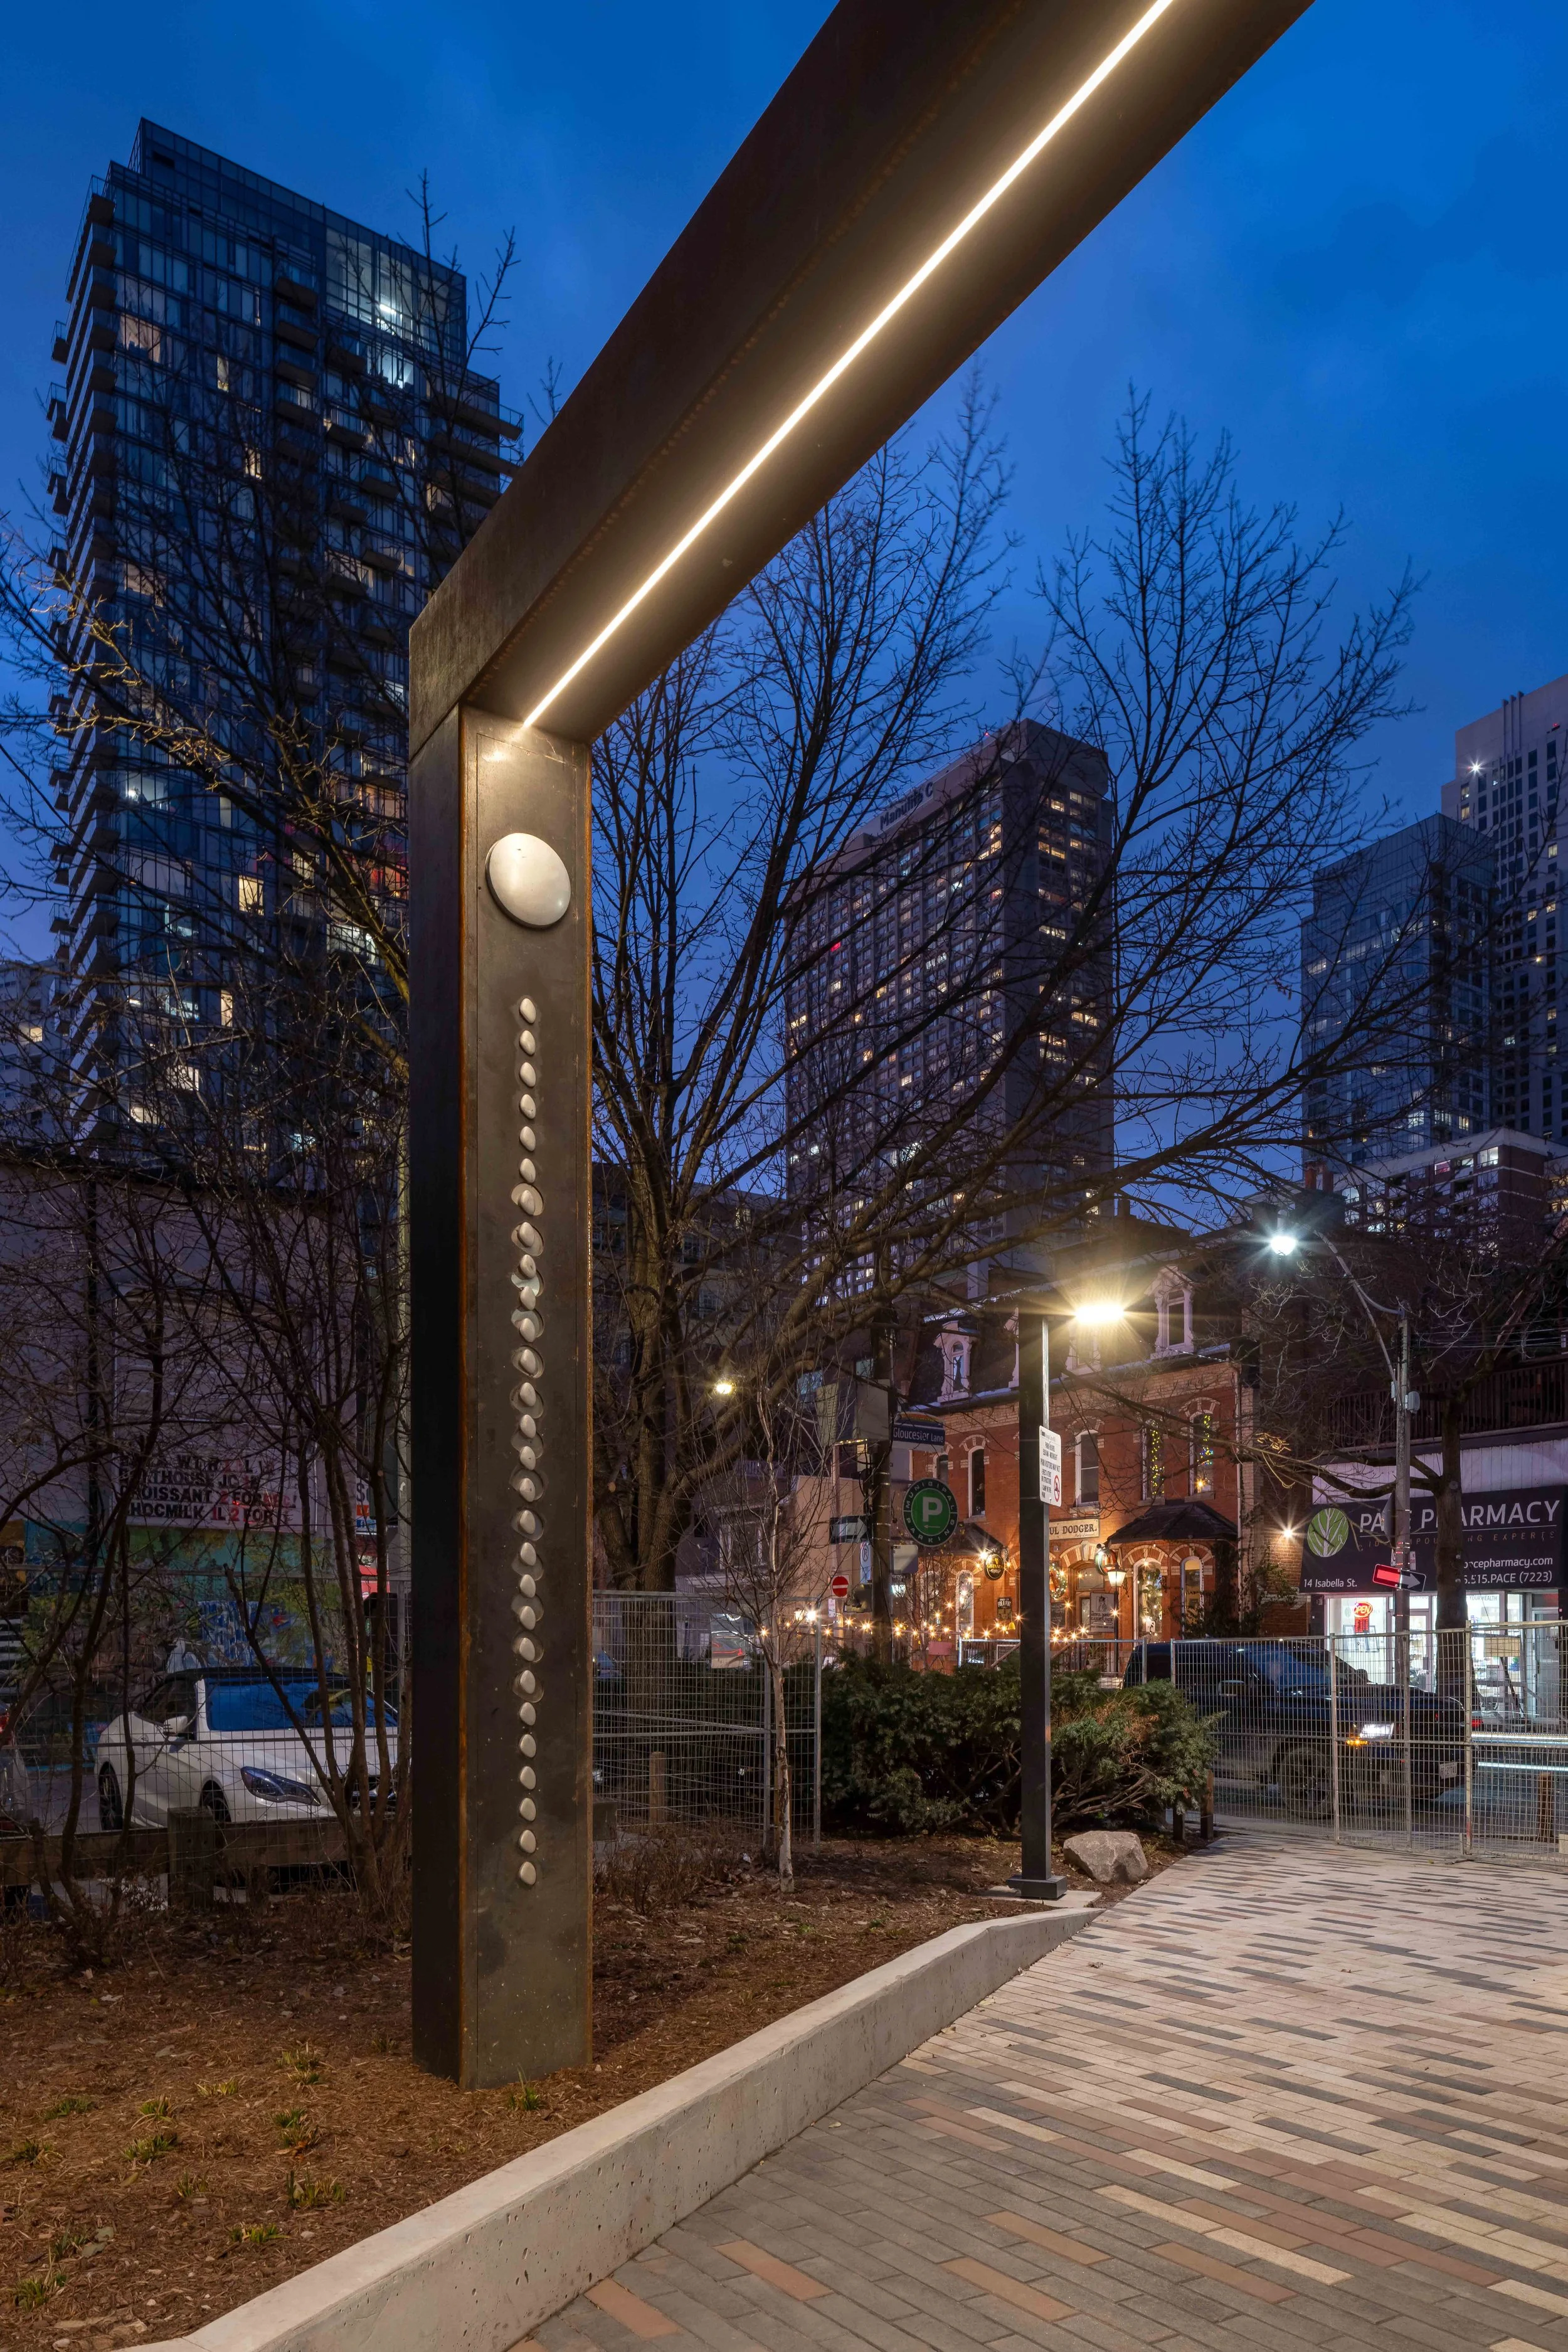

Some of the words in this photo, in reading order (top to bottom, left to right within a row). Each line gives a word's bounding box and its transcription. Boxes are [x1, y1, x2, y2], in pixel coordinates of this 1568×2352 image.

[880, 790, 923, 830] Manulife
[893, 1427, 930, 1442] Gloucester
[931, 1433, 944, 1443] Lane
[120, 1485, 212, 1503] COISSANT
[906, 1481, 955, 1510] MUNICIPAL
[129, 1502, 204, 1520] HOCMILK
[231, 1508, 240, 1522] 2
[923, 1496, 942, 1523] P
[1421, 1500, 1560, 1528] PARMACY
[906, 1517, 955, 1544] PARKING
[1493, 1531, 1555, 1542] EXPERTS
[1304, 1579, 1312, 1588] 14
[1315, 1578, 1344, 1587] Isabella
[1347, 1578, 1357, 1587] St.
[1520, 1570, 1552, 1584] (7223)
[1355, 1606, 1370, 1614] OPEN
